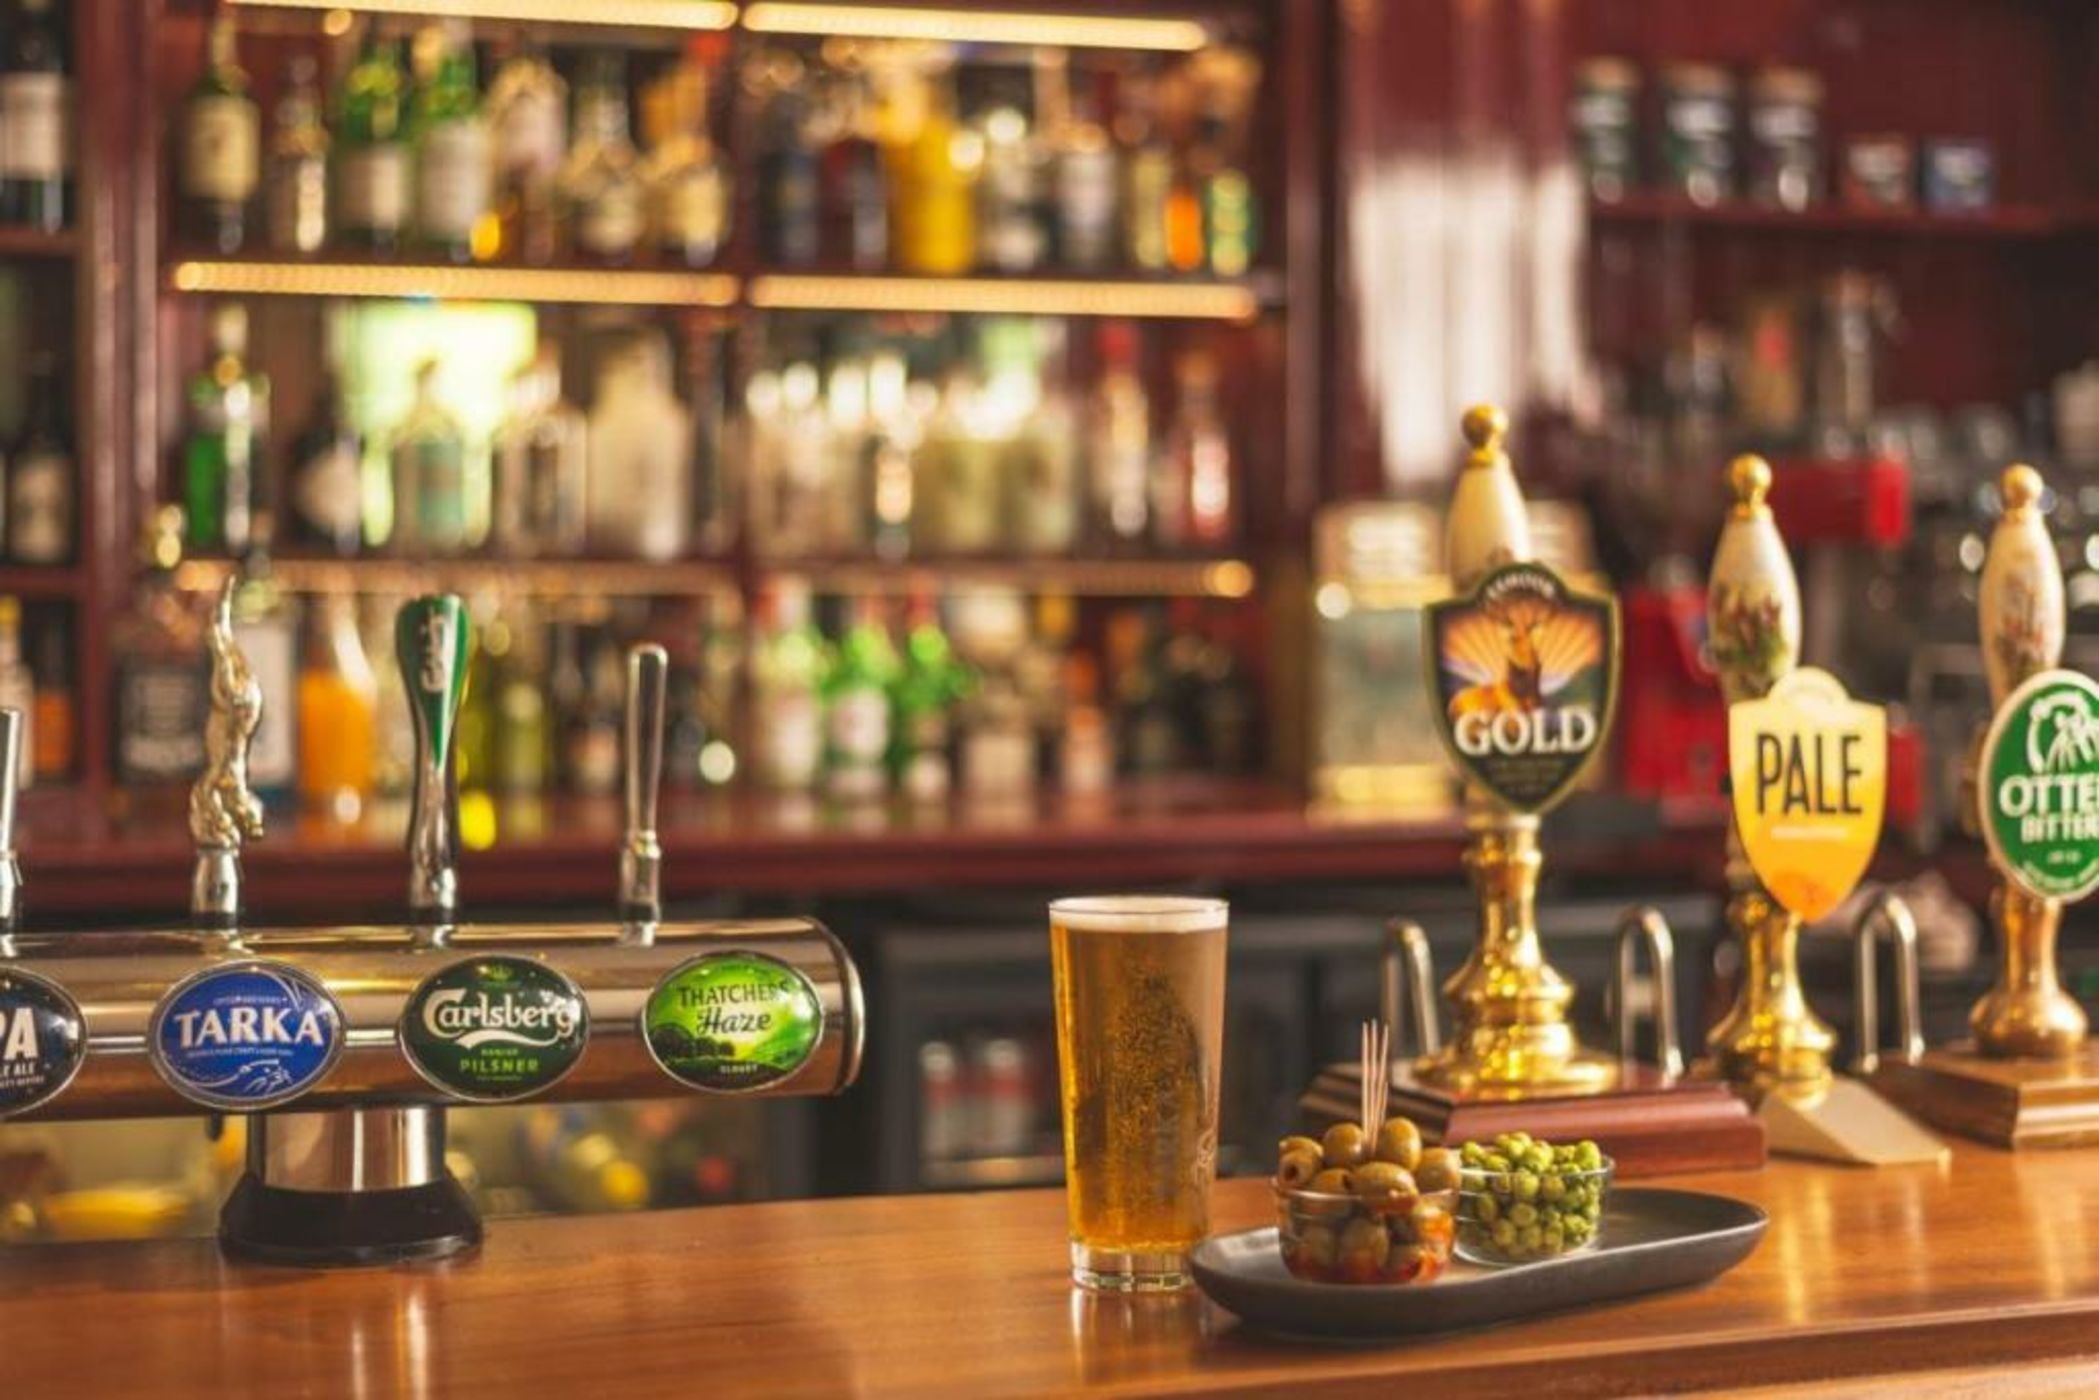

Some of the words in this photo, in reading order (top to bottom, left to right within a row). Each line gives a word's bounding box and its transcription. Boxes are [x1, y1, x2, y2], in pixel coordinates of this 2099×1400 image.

[1454, 704, 1597, 756] GOLD
[1756, 733, 1863, 815] PALE
[1999, 773, 2099, 818] OTTE
[174, 1006, 325, 1048] TARKA
[423, 988, 579, 1047] Carlsberg
[697, 1006, 772, 1036] Haze
[460, 1058, 540, 1073] PILSNER
